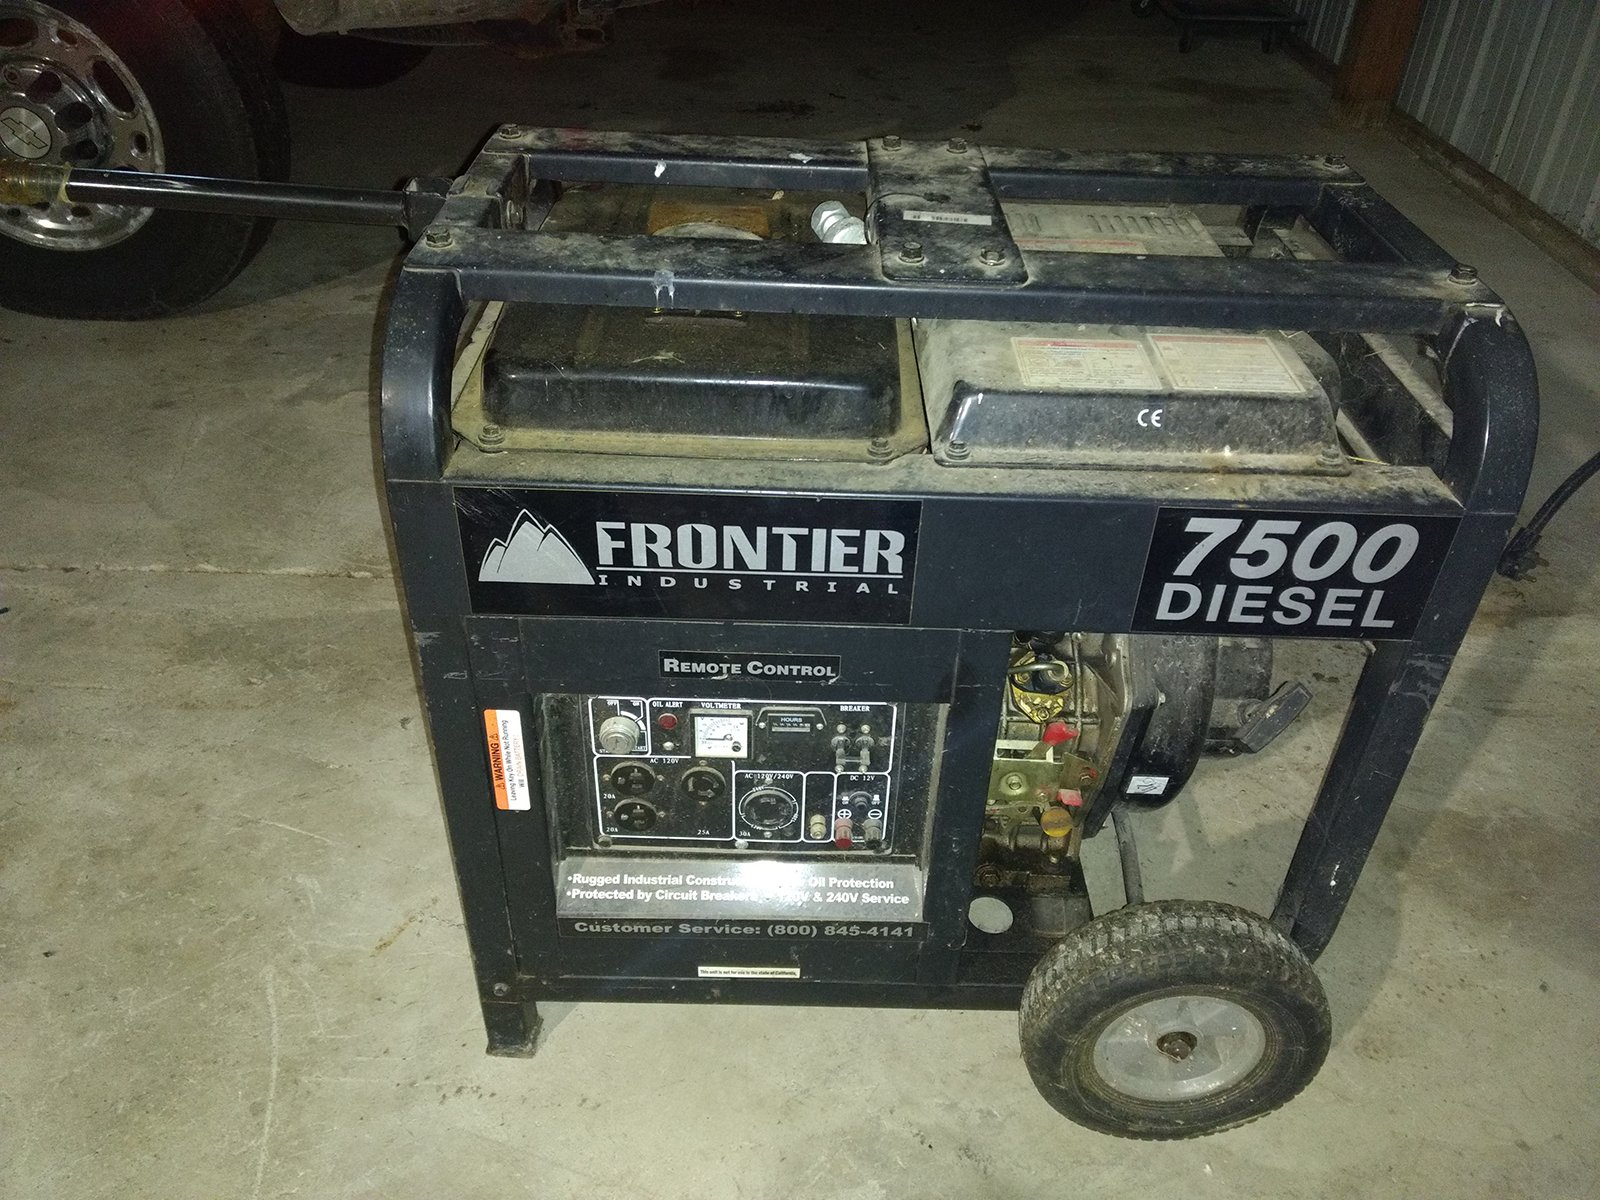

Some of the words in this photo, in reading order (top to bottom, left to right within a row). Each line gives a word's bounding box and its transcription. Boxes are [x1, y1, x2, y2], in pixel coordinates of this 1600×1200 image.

[1137, 408, 1163, 427] CE
[596, 520, 906, 574] FRONTIER
[1172, 516, 1420, 584] 7500
[598, 574, 899, 594] INDUSTRIAL
[1155, 582, 1395, 628] DIESEL
[663, 658, 742, 675] REMOTE
[746, 660, 836, 677] CONTROL
[490, 742, 502, 781] WARNING
[623, 874, 683, 885] Industrial
[809, 877, 826, 888] Oil
[829, 878, 894, 889] Protection
[637, 889, 652, 902] by
[655, 890, 697, 901] Circuit
[813, 893, 823, 903] &
[826, 892, 858, 903] 240V
[861, 894, 910, 904] Service
[574, 922, 672, 933] Customer
[678, 923, 761, 935] Service:
[767, 925, 818, 937] (800)
[824, 926, 914, 937] 845-4141
